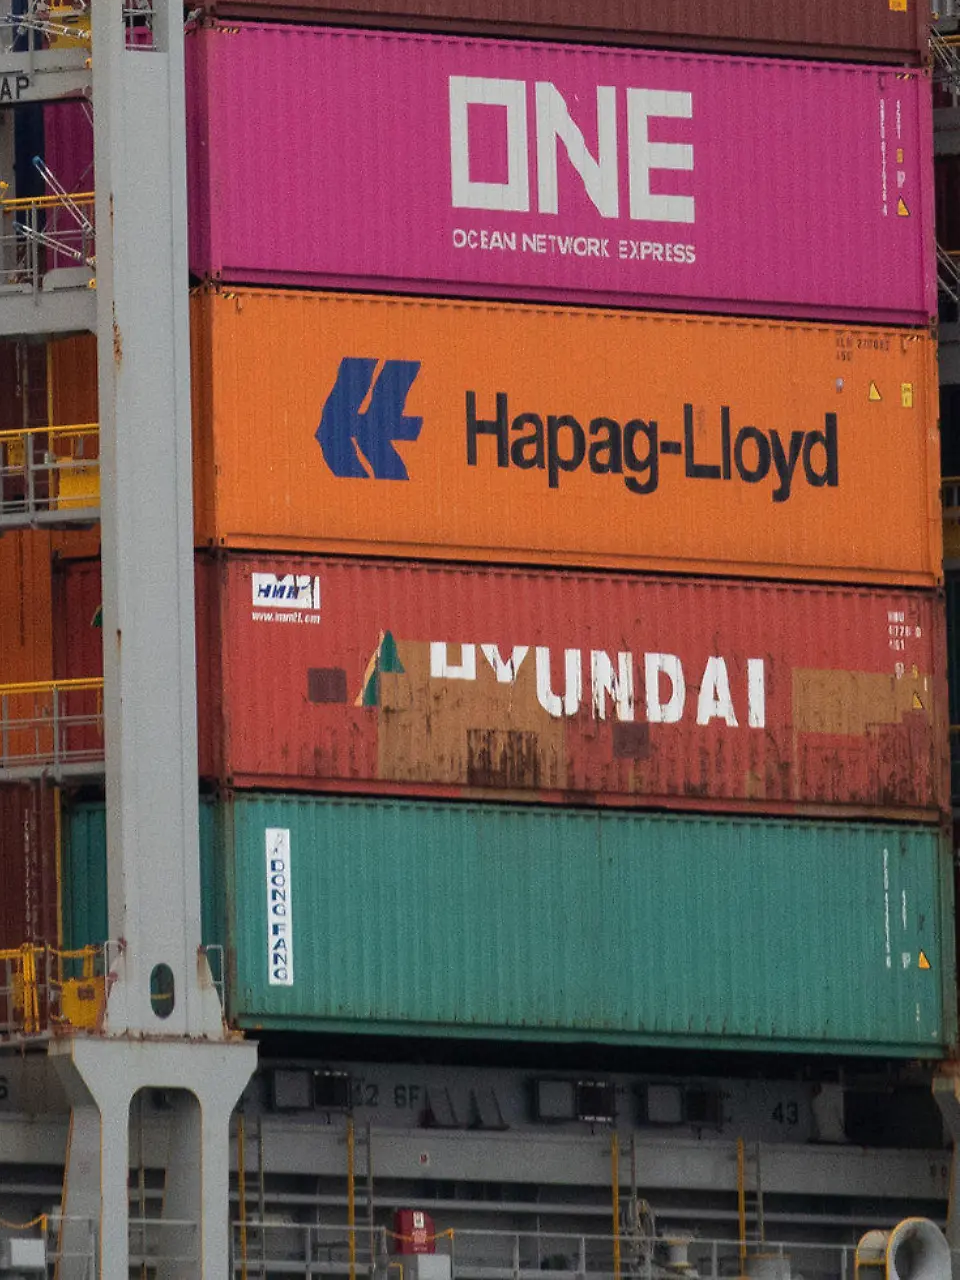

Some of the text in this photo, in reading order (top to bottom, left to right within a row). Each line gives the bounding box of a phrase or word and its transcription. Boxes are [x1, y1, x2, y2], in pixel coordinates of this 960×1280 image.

[449, 75, 695, 224] ONE
[452, 229, 696, 263] OCEAN NETWORK EXPRESS
[465, 390, 839, 502] Hapag-Lloyd
[430, 641, 766, 728] HYUNDAI
